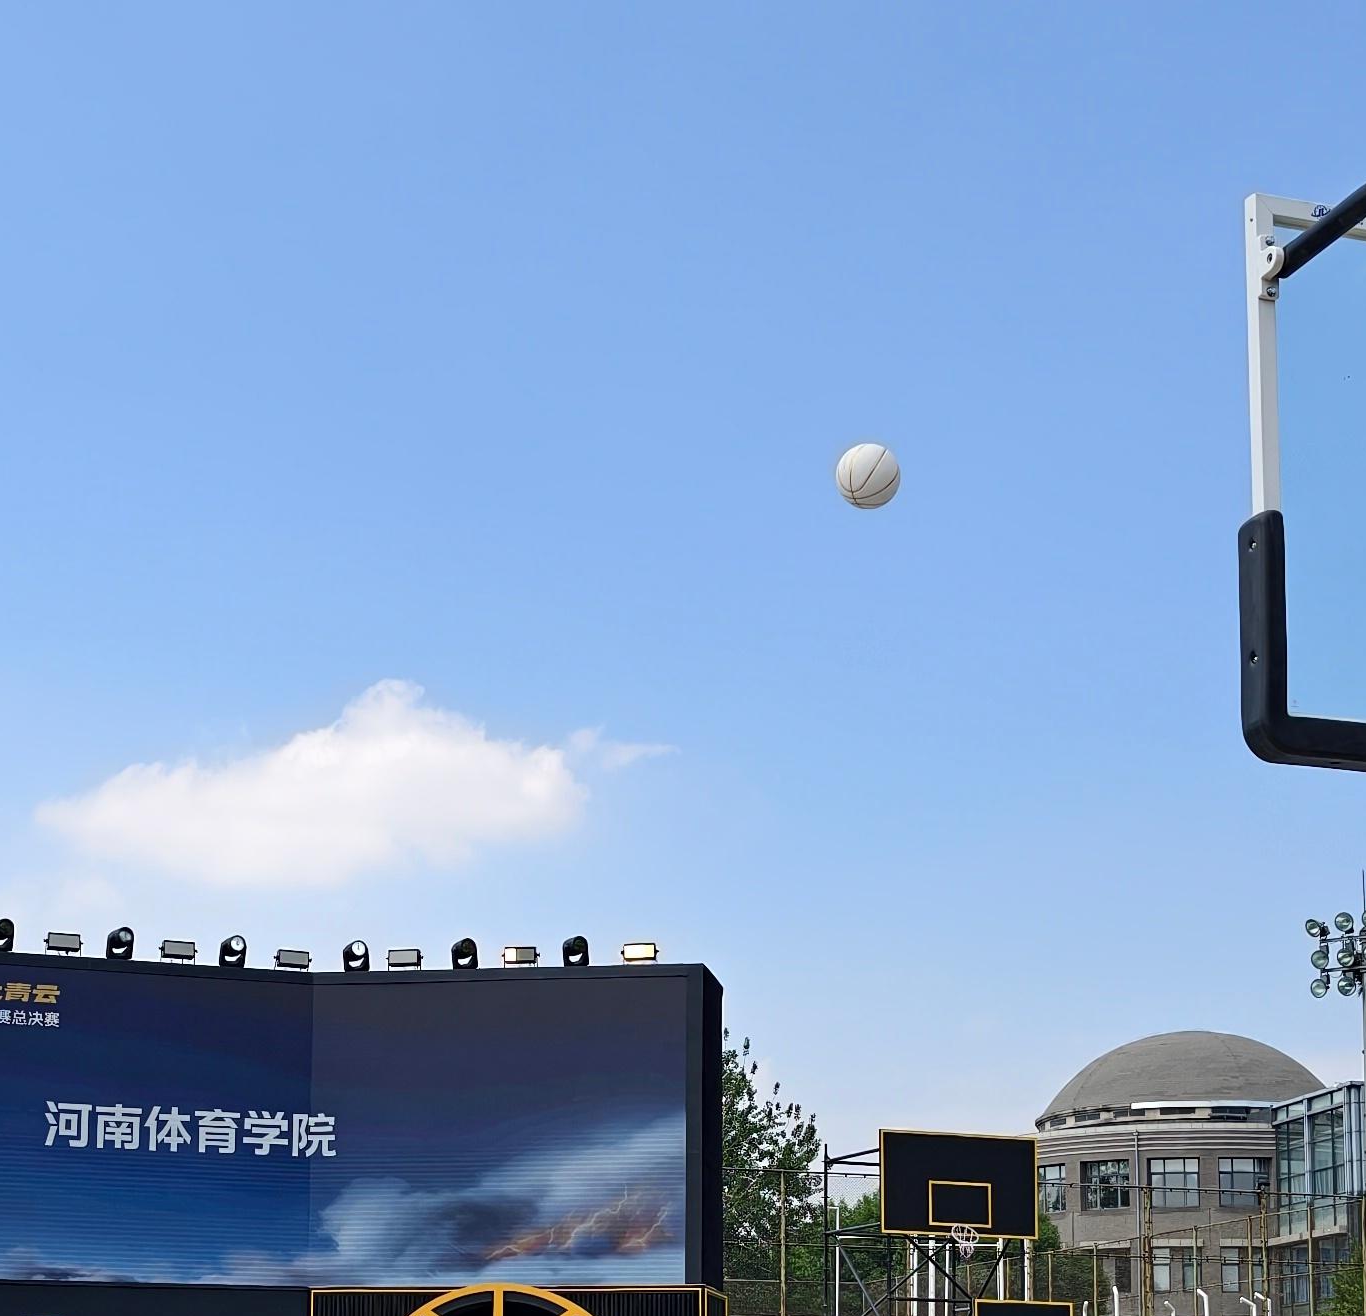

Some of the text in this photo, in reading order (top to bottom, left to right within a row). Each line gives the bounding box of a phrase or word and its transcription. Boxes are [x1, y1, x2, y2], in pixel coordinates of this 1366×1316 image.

[43, 1100, 338, 1158] 河南体育学院
